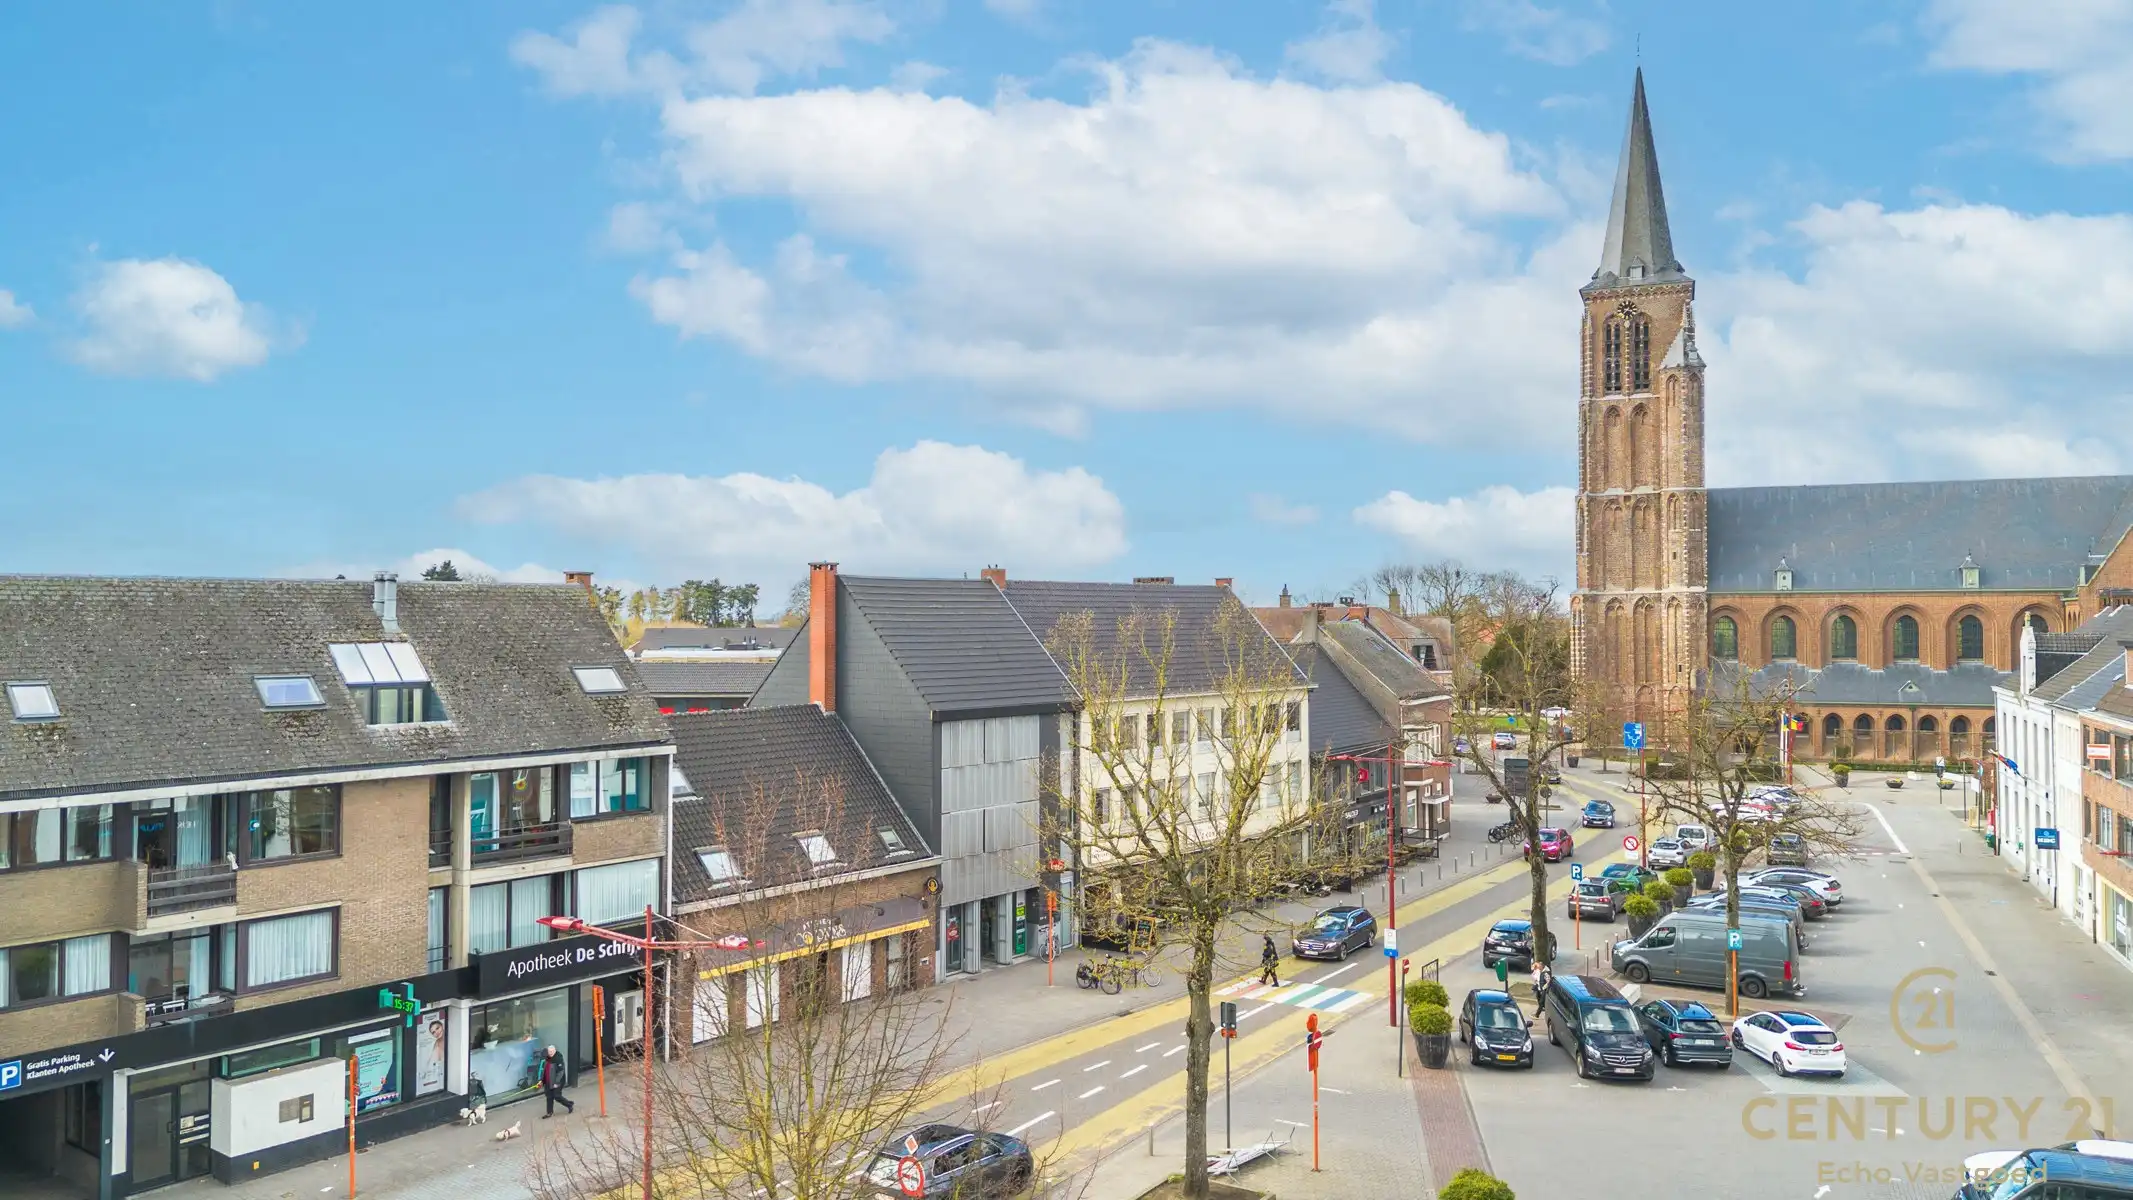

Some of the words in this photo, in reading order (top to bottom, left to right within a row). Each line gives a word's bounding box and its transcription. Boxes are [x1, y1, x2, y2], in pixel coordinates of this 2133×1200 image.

[507, 949, 572, 978] Apotheek
[576, 947, 595, 963] De
[394, 998, 414, 1012] 15:37
[26, 1060, 50, 1070] Gratis
[51, 1054, 80, 1066] Parking
[26, 1067, 57, 1080] Klanten
[59, 1059, 95, 1074] Apotheek
[1, 1065, 18, 1086] P
